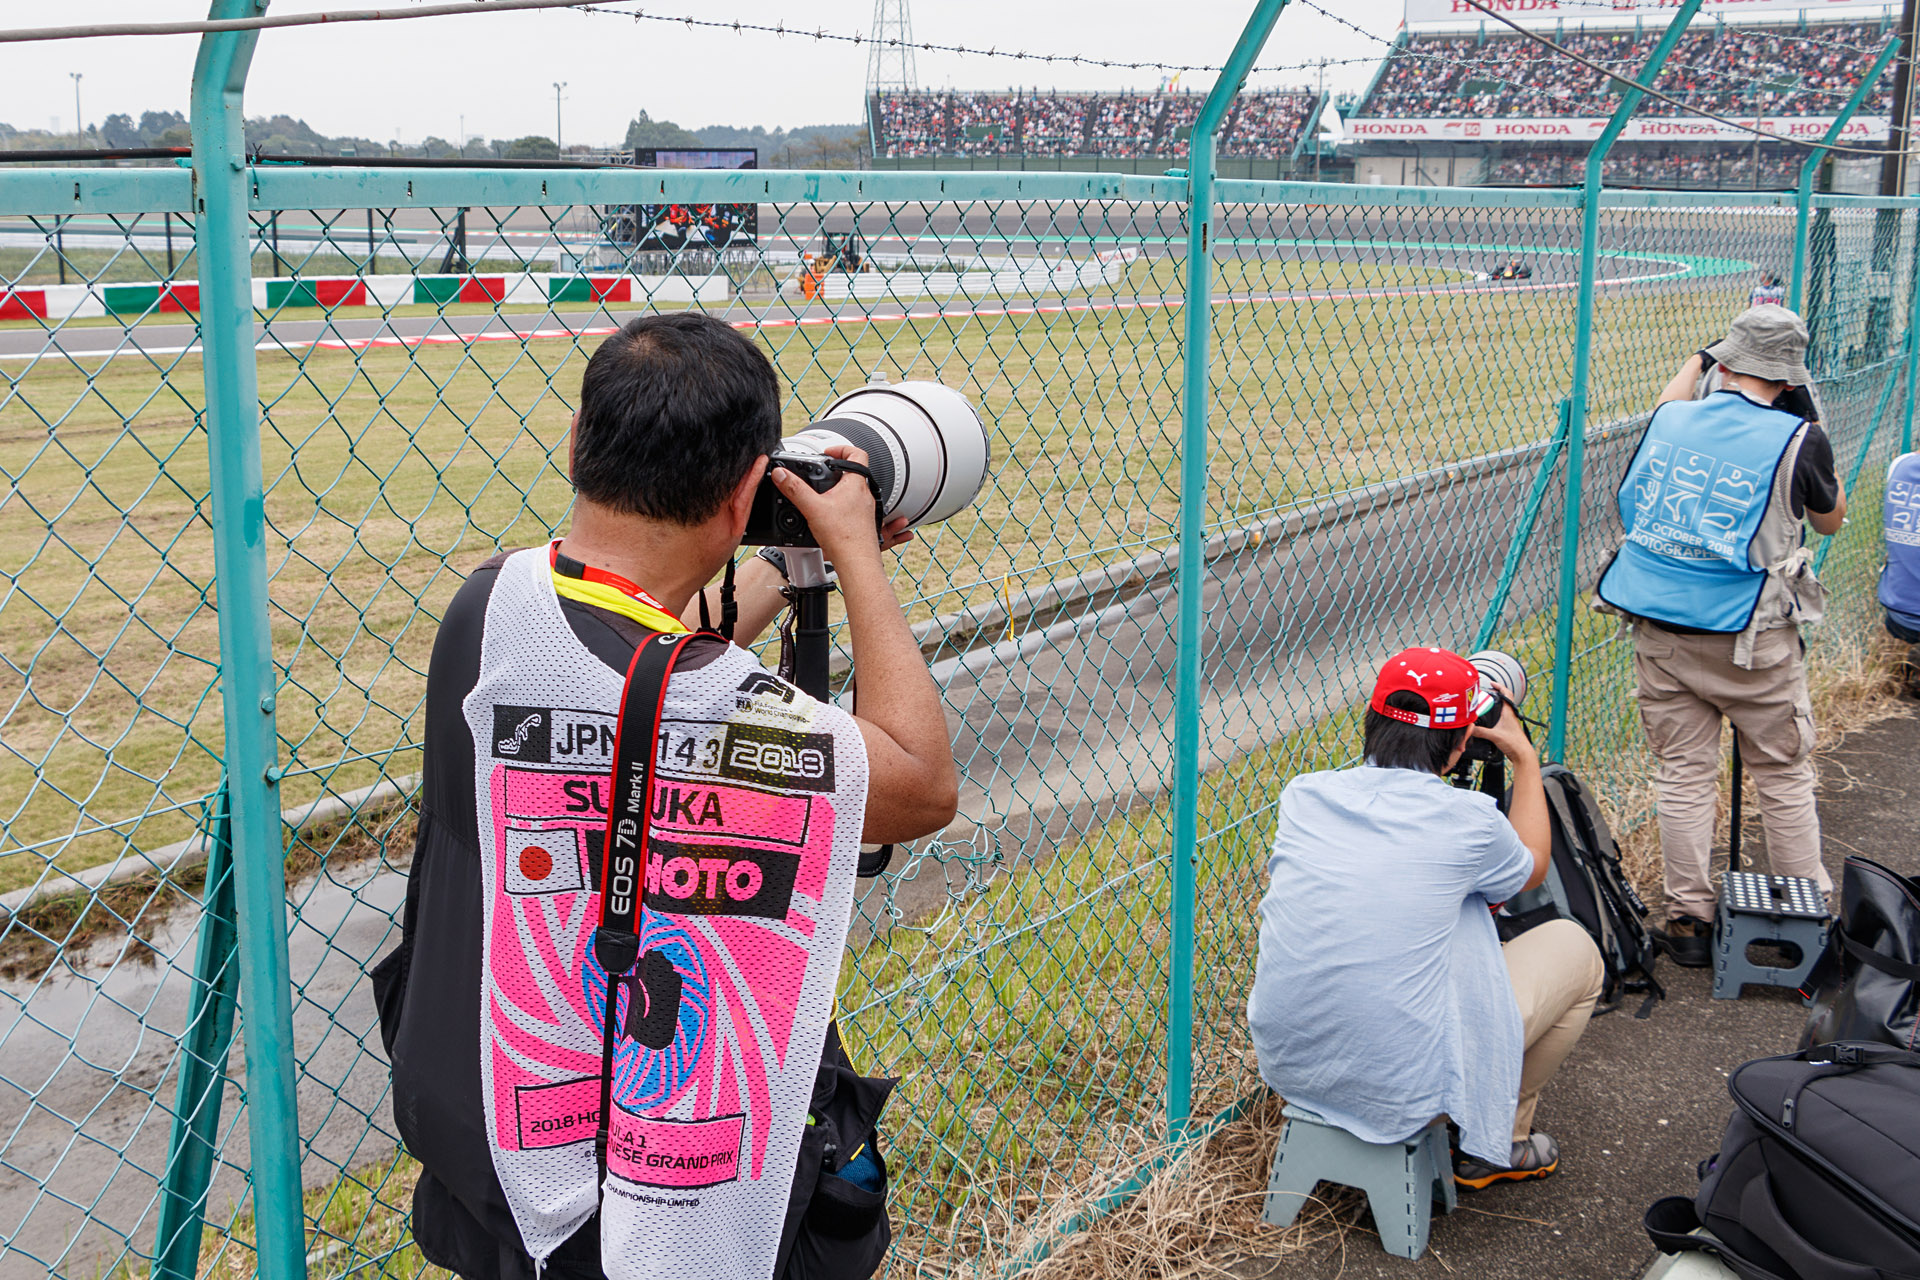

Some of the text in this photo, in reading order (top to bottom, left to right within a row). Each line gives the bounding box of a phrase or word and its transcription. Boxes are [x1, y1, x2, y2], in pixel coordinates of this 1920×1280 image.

[1450, 0, 1560, 13] HONDA
[1353, 123, 1428, 135] HONDA
[1495, 123, 1572, 135] HONDA
[1640, 123, 1719, 135] HONDA
[1688, 455, 1699, 467] C
[1730, 469, 1743, 480] D
[1651, 522, 1704, 547] OCTOBER
[1707, 539, 1735, 556] 2018
[754, 707, 774, 716] World
[729, 738, 825, 779] 2018
[563, 780, 724, 827] SUUKA
[610, 761, 644, 916] EOS 7D Mark II
[644, 848, 764, 902] HOTO
[530, 1115, 575, 1133] 2018
[646, 1153, 709, 1170] GRAND
[710, 1149, 735, 1168] PRIX
[667, 1198, 700, 1207] LIMITED
